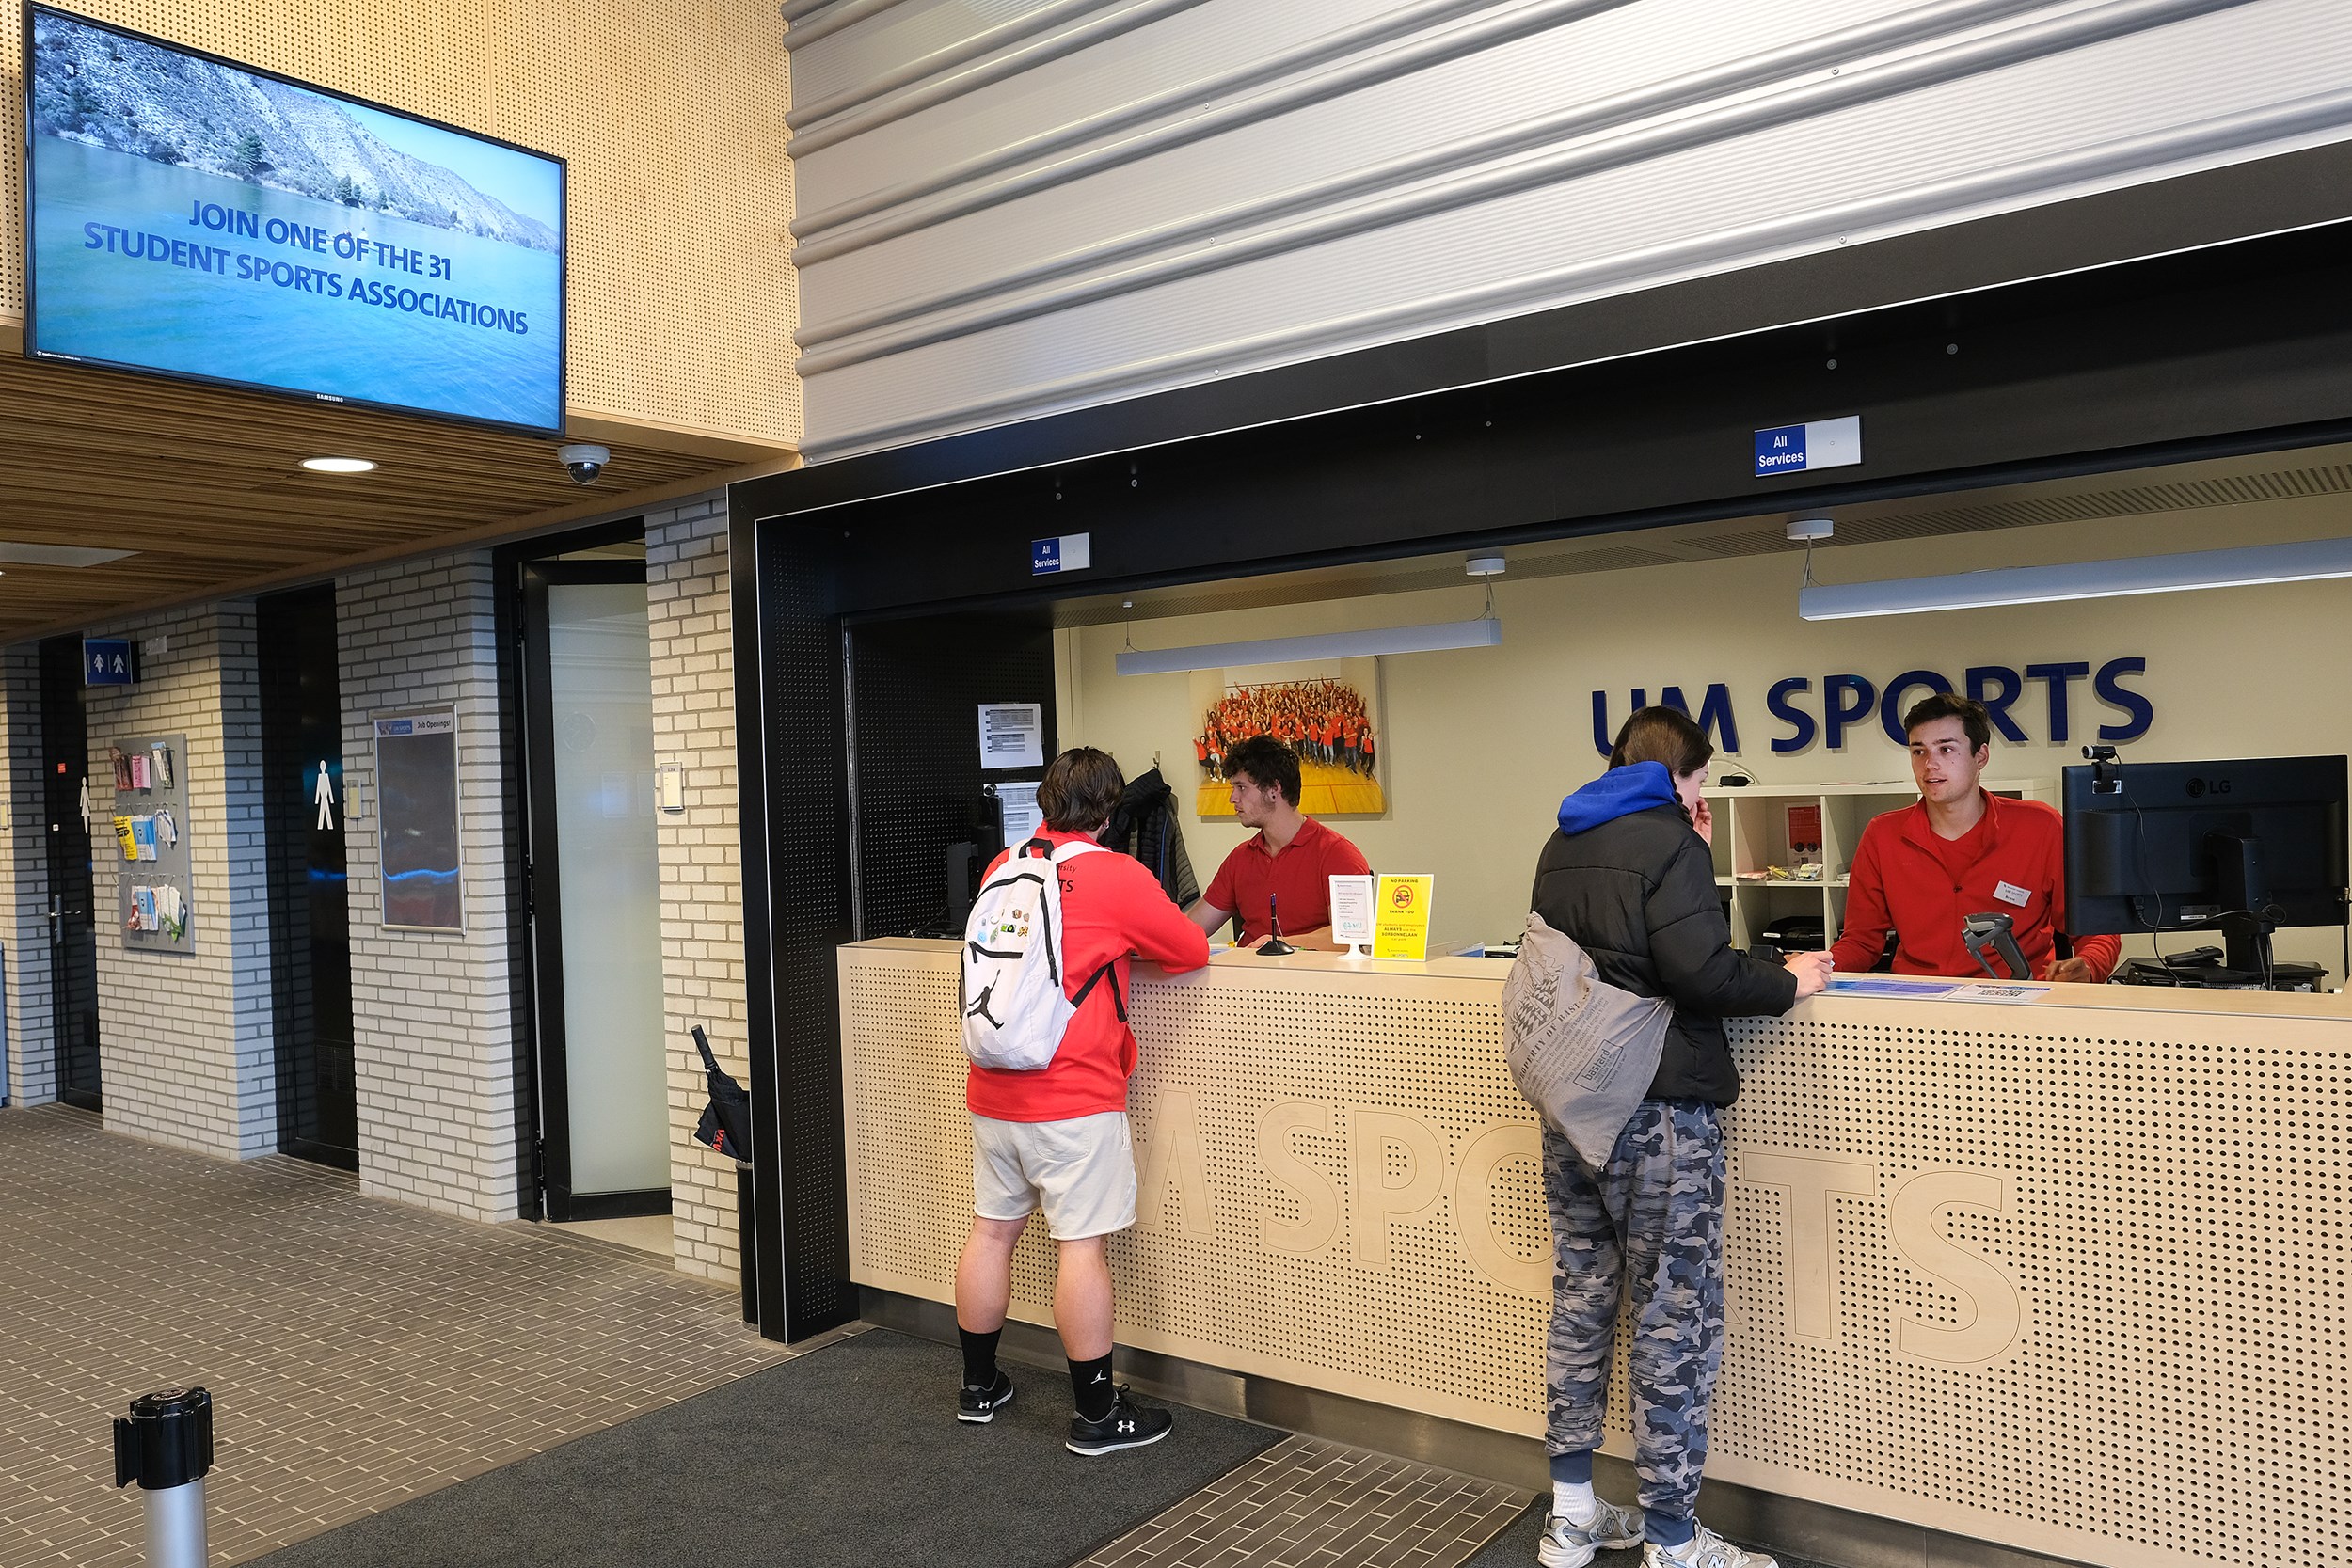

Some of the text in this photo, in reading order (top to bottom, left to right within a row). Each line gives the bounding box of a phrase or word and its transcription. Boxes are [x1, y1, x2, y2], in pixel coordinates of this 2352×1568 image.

[189, 200, 451, 280] JOIN ONE OF THE 31
[84, 221, 528, 335] STUDENT SPORTS ASSOCIATIONS
[1773, 435, 1788, 448] All
[1758, 452, 1804, 467] Services
[1034, 558, 1060, 569] Services
[1041, 545, 1051, 555] All
[1592, 657, 2153, 757] UM SPORTS
[2209, 779, 2231, 794] LG
[1518, 1037, 1546, 1084] PROPERTY
[1544, 1022, 1559, 1037] OF
[1581, 1048, 1611, 1081] bastard
[1258, 1101, 2021, 1364] SPOTS
